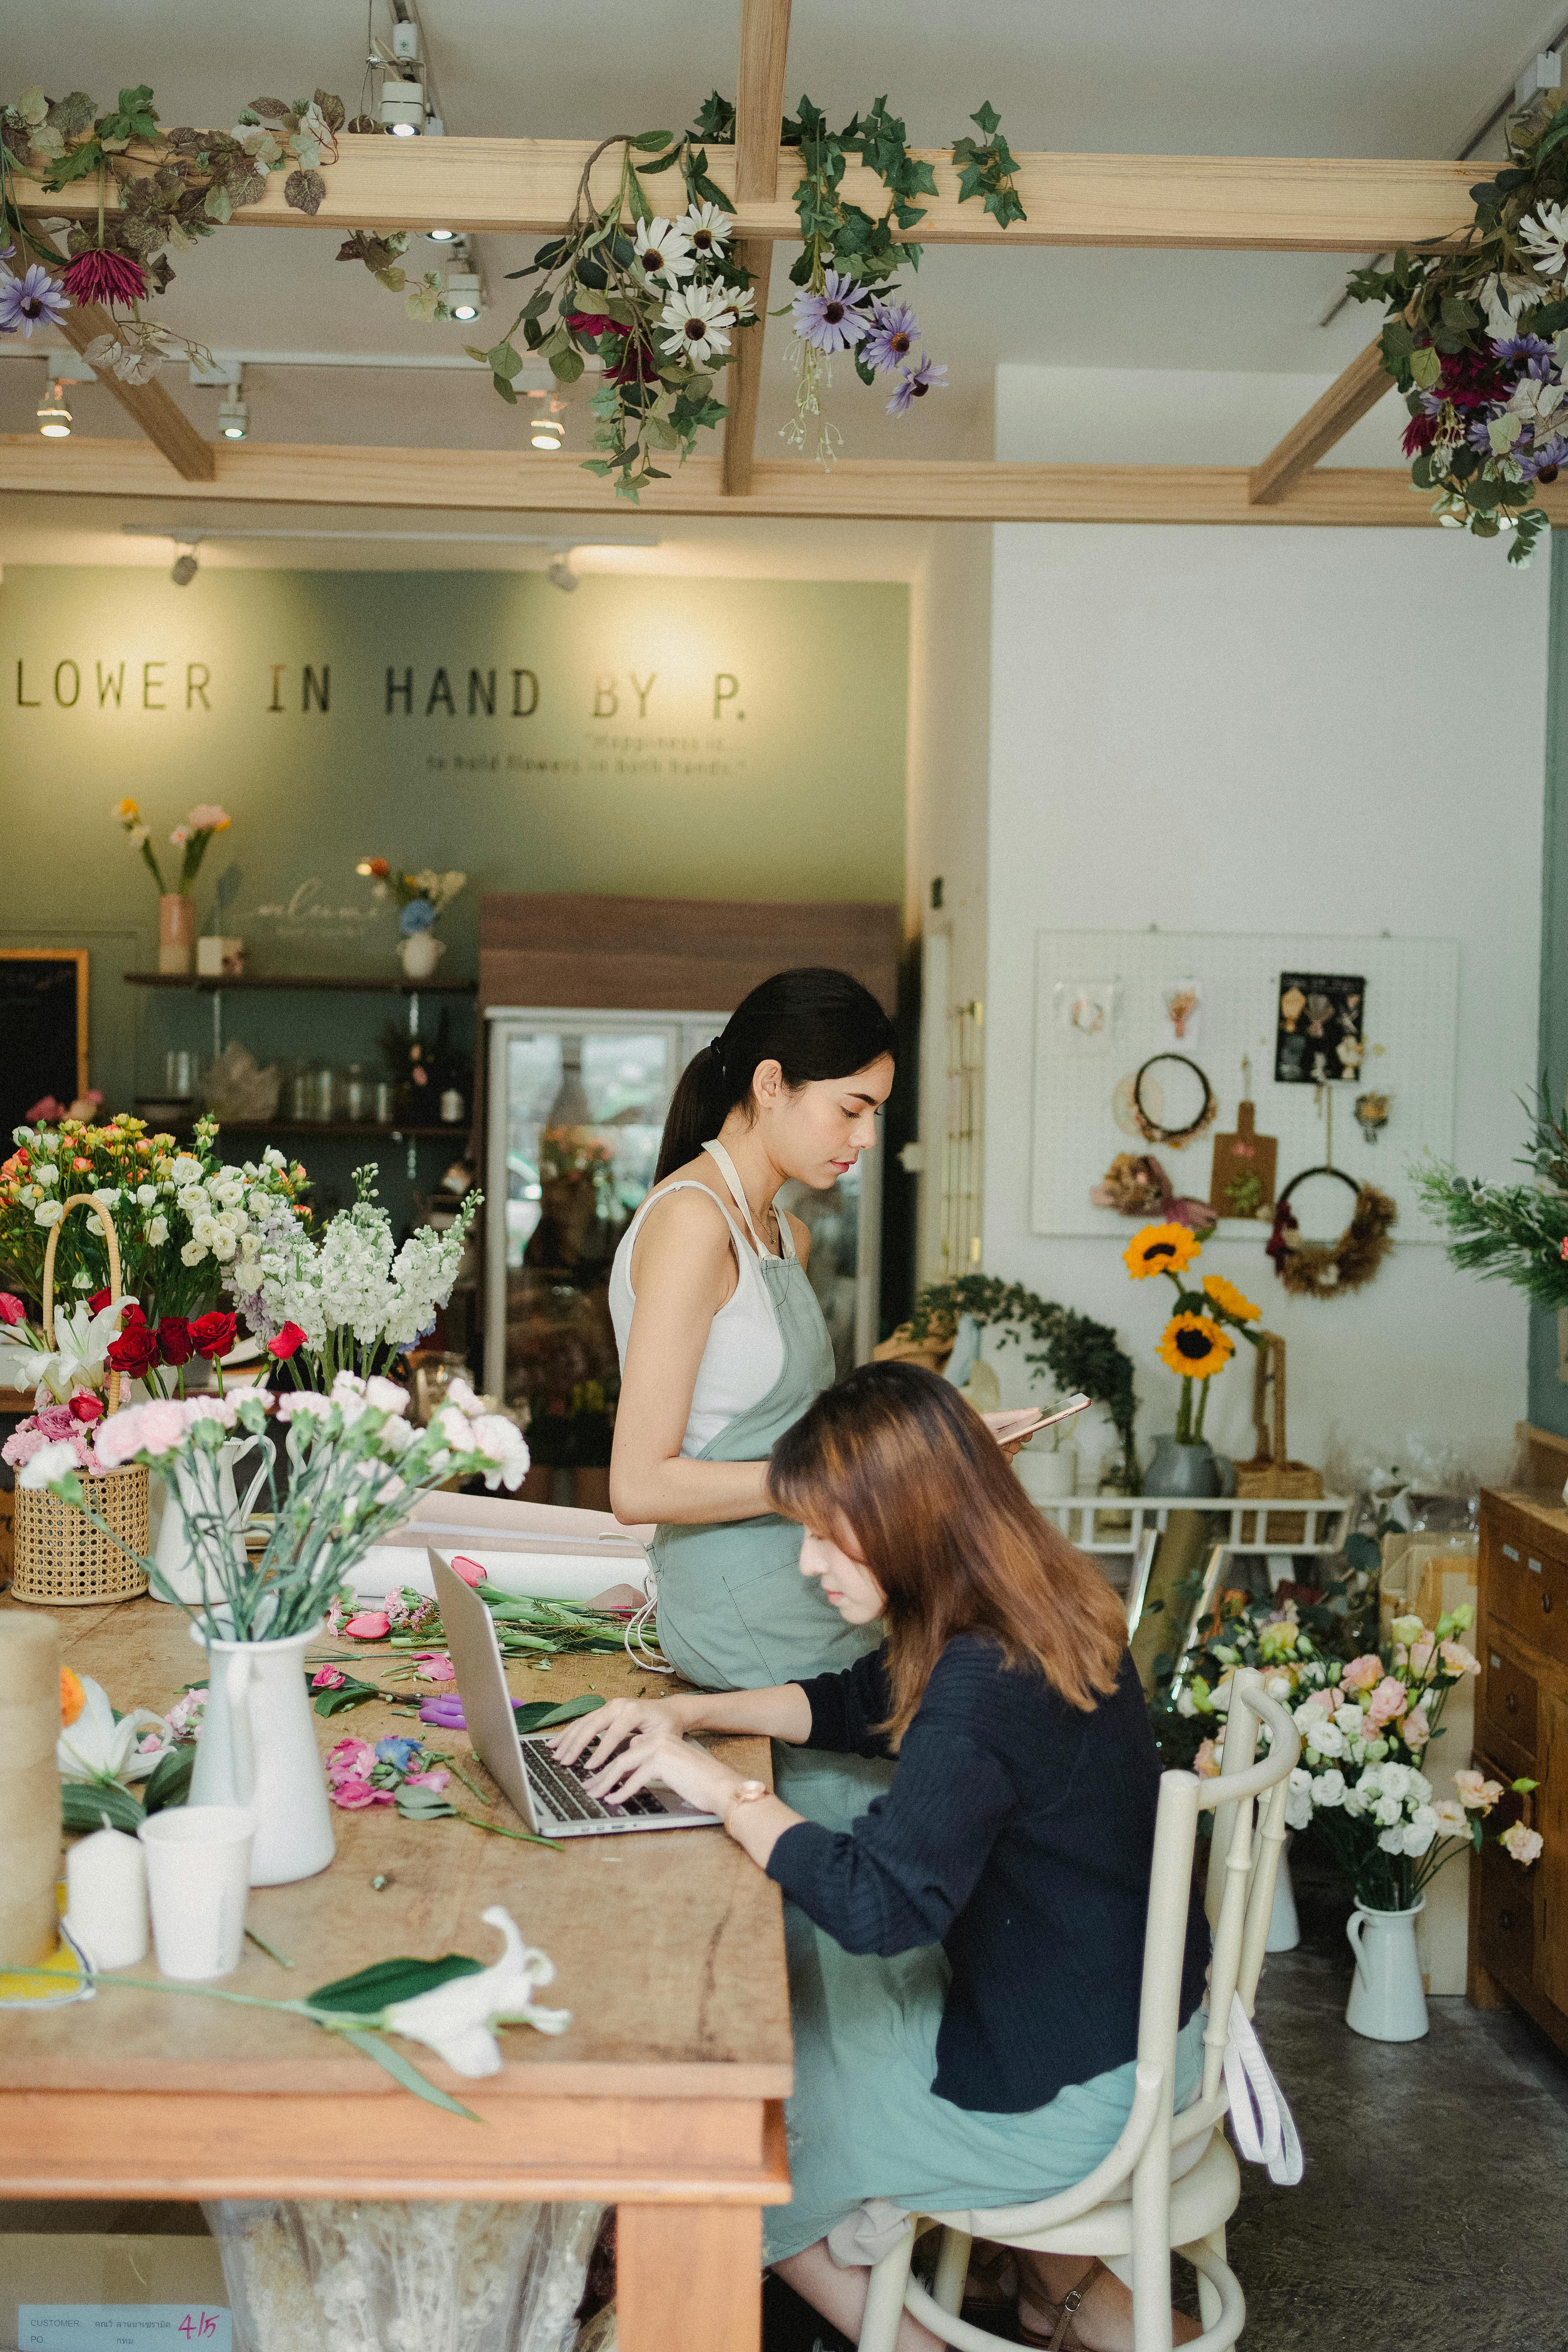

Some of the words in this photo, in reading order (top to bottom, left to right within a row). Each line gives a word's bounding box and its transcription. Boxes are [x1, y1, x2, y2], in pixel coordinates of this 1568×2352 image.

[18, 658, 212, 710] LOWER
[267, 663, 331, 713] IN
[385, 666, 540, 719] HAND
[592, 670, 657, 720] BY
[713, 673, 746, 721] P.
[178, 2312, 220, 2340] 4/5
